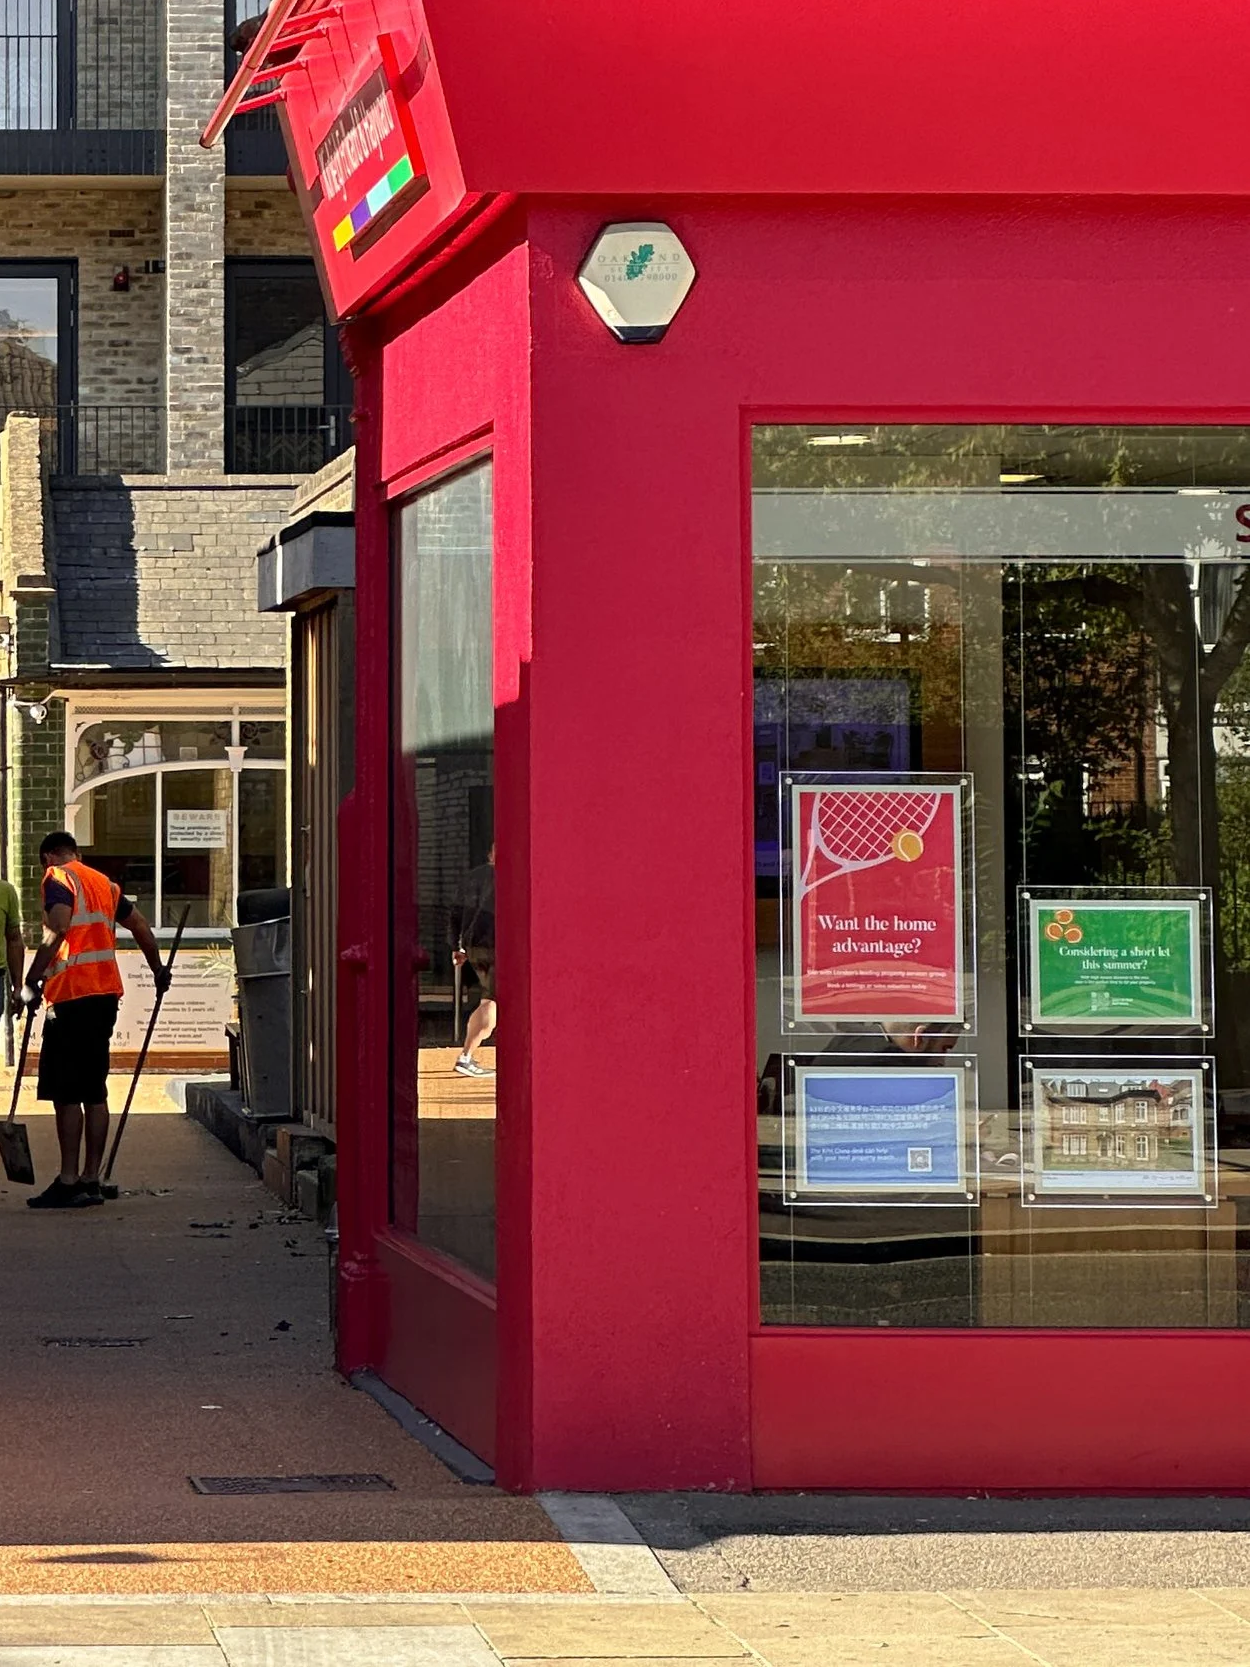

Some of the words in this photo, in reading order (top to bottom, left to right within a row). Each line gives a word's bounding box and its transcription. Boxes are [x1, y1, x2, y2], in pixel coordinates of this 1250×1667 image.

[173, 813, 220, 821] BEWARE
[818, 915, 860, 931] Want
[864, 915, 889, 931] the
[893, 915, 937, 931] home
[832, 937, 922, 958] advantage?
[1059, 946, 1119, 959] Considering
[1121, 949, 1127, 957] a
[1130, 946, 1155, 957] short
[1158, 946, 1170, 957] let
[1082, 960, 1100, 970] this
[1103, 960, 1148, 970] summer?
